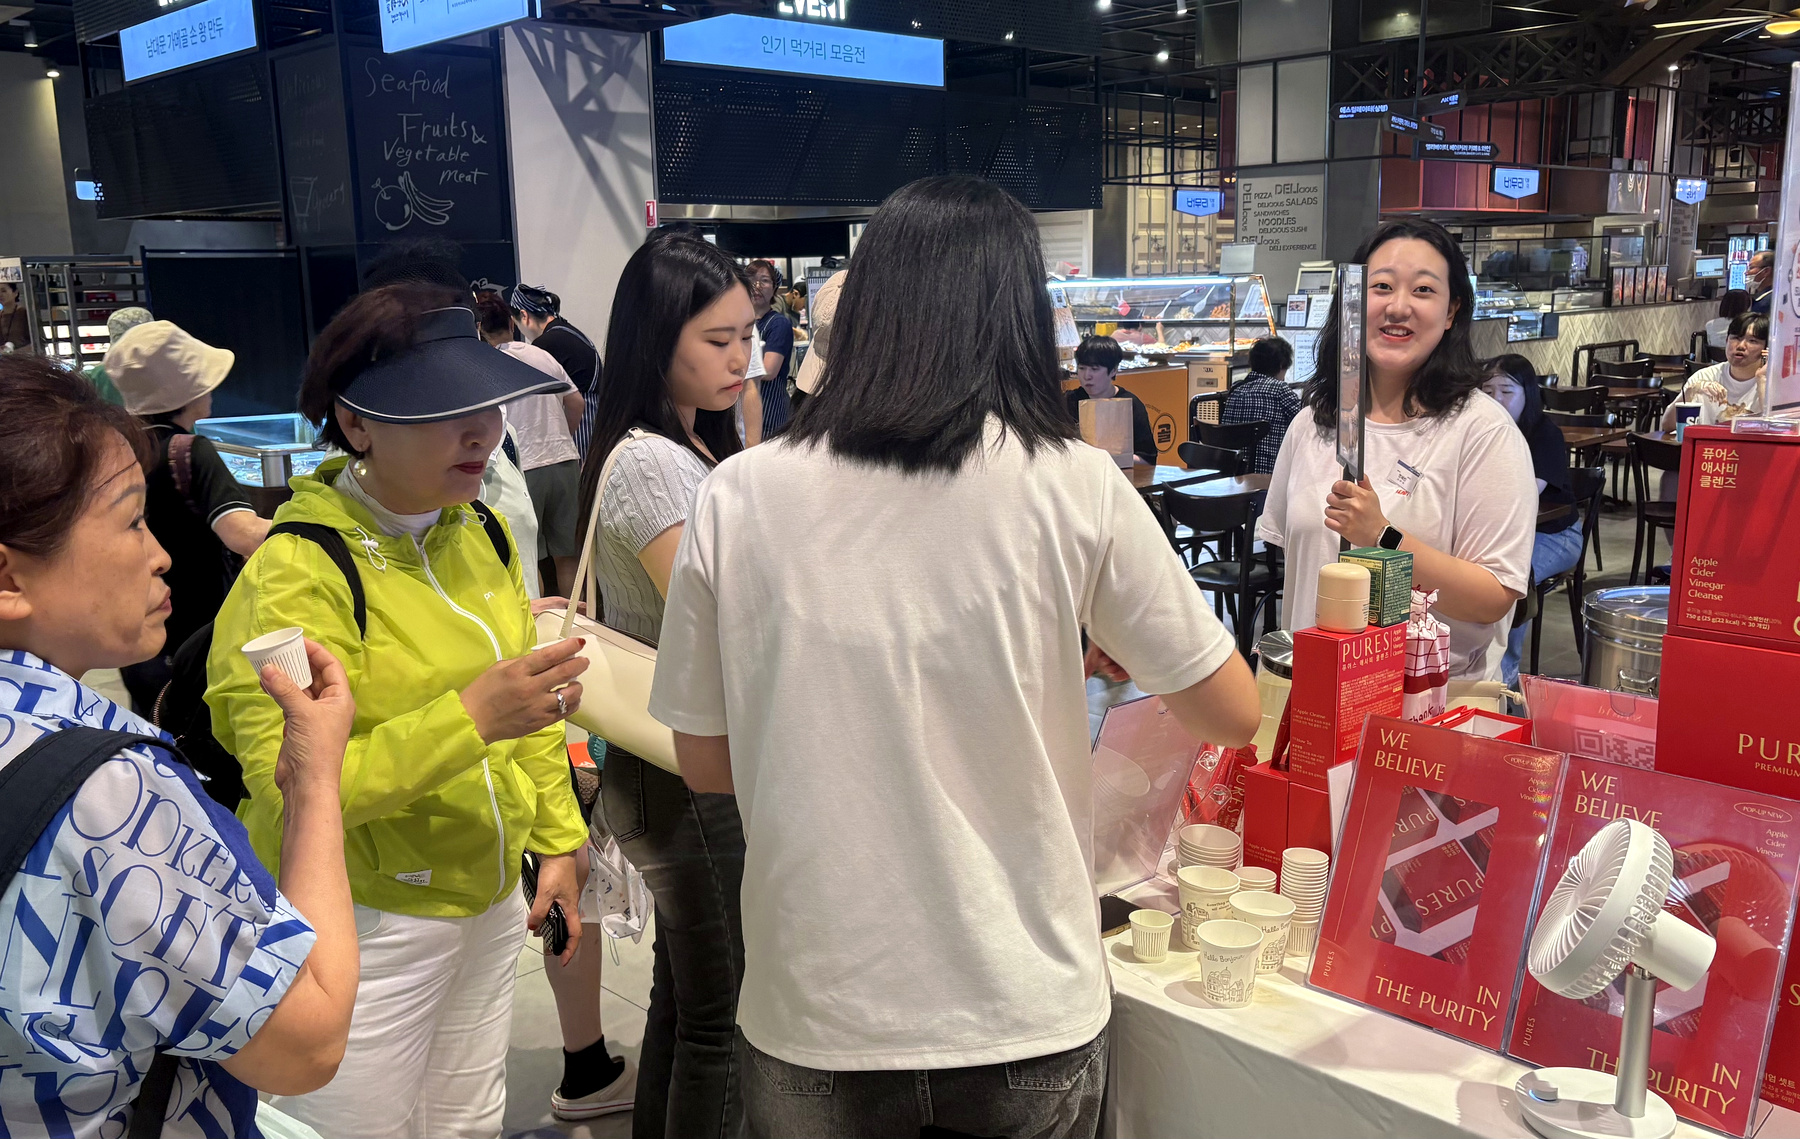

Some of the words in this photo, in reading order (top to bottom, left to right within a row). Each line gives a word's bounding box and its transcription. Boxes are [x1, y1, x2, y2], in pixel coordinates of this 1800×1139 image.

[146, 35, 167, 58] 남대문
[189, 29, 198, 45] 손
[198, 22, 207, 43] 왕
[207, 17, 224, 40] 만두
[761, 36, 786, 56] 인기
[790, 40, 827, 60] 먹거리
[830, 44, 866, 64] 모음전
[365, 57, 451, 104] Seafood
[384, 137, 470, 168] Vegetable
[1254, 192, 1272, 200] PIZZA
[1285, 197, 1318, 206] SALADS
[1258, 217, 1296, 226] NOODLES
[1702, 447, 1740, 461] 퓨어스
[1700, 461, 1738, 475] 애사비
[1699, 475, 1737, 489] 클렌즈
[1690, 556, 1718, 567] Apple
[1689, 567, 1716, 578] Cider
[1688, 578, 1726, 591] Vinegar
[1688, 589, 1724, 601] Cleanse
[1342, 631, 1389, 663] PURES
[1381, 728, 1411, 750] WE
[1374, 750, 1446, 782] BELIEVE
[1581, 770, 1618, 795] WE
[1765, 838, 1786, 848] Cider
[1766, 829, 1789, 839] Apple
[1756, 846, 1785, 858] Vinegar
[1261, 925, 1279, 935] Hello
[1323, 950, 1335, 977] PURES
[1375, 975, 1414, 1005] THE
[1418, 991, 1496, 1032] PURITY
[1476, 985, 1501, 1010] IN
[1523, 1016, 1536, 1046] PURES
[1586, 1047, 1619, 1075] TH
[1712, 1062, 1742, 1090] IN
